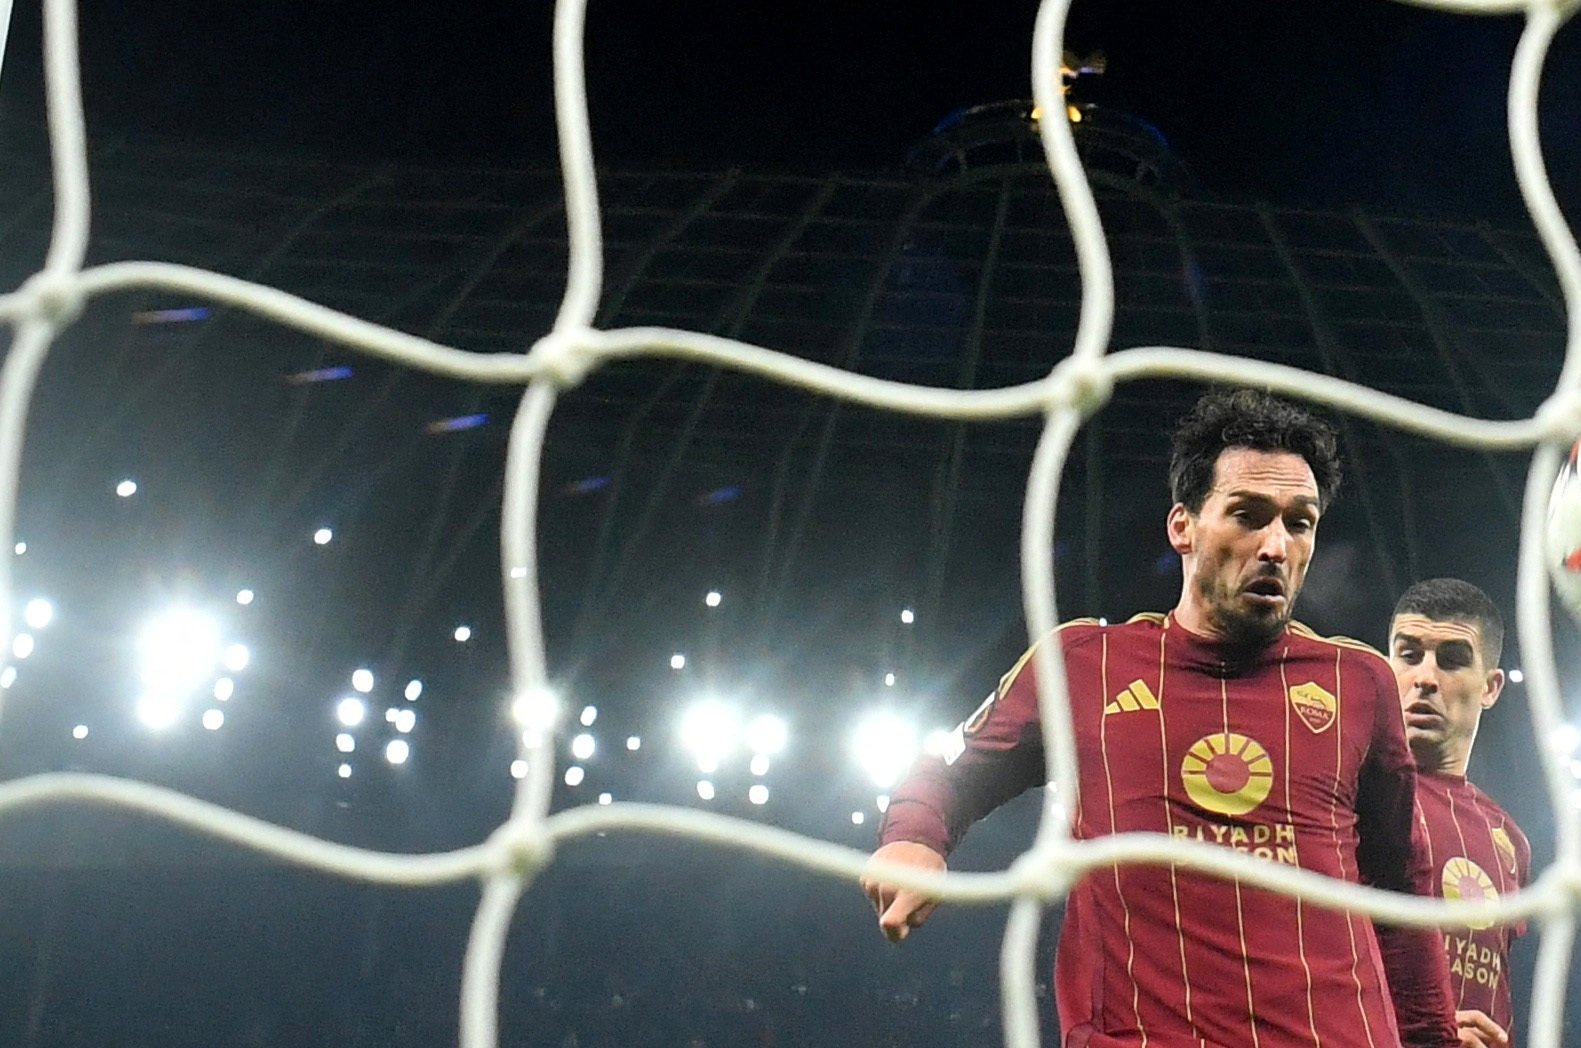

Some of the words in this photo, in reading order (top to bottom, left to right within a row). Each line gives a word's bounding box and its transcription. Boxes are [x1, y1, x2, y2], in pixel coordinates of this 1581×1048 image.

[1173, 824, 1295, 843] RIYADH
[1444, 934, 1501, 971] IYADH
[1450, 957, 1499, 990] ASON
